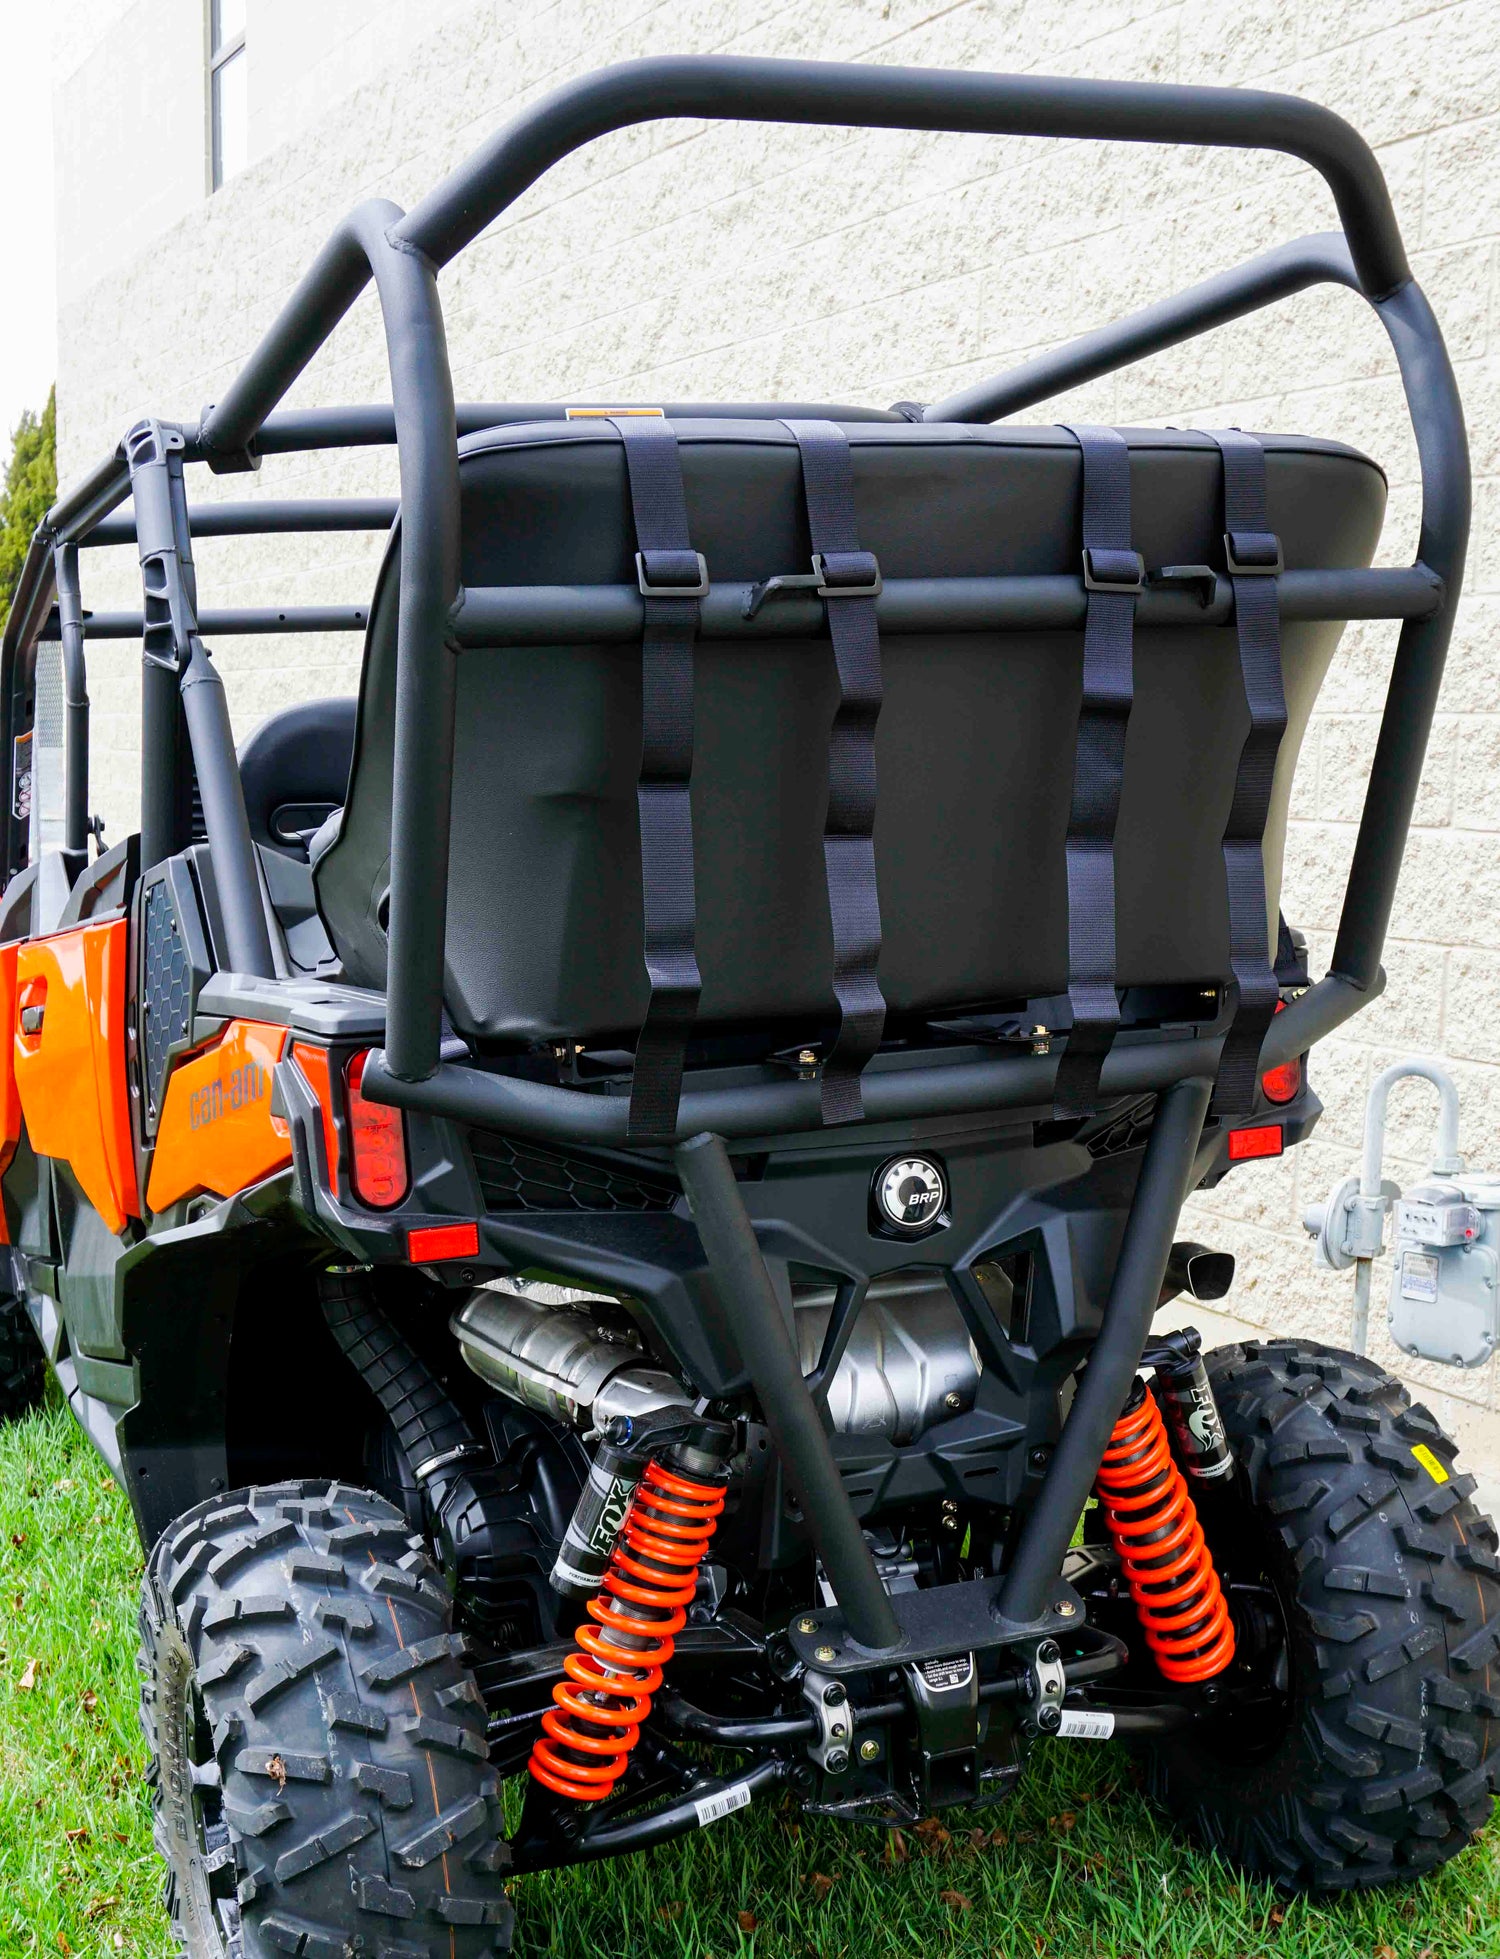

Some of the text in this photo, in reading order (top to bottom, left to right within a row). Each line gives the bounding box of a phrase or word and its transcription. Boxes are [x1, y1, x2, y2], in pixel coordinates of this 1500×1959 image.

[189, 1059, 264, 1131] can-am
[908, 1191, 939, 1206] BRP
[1190, 1384, 1224, 1450] FOX
[590, 1477, 637, 1556] FOX
